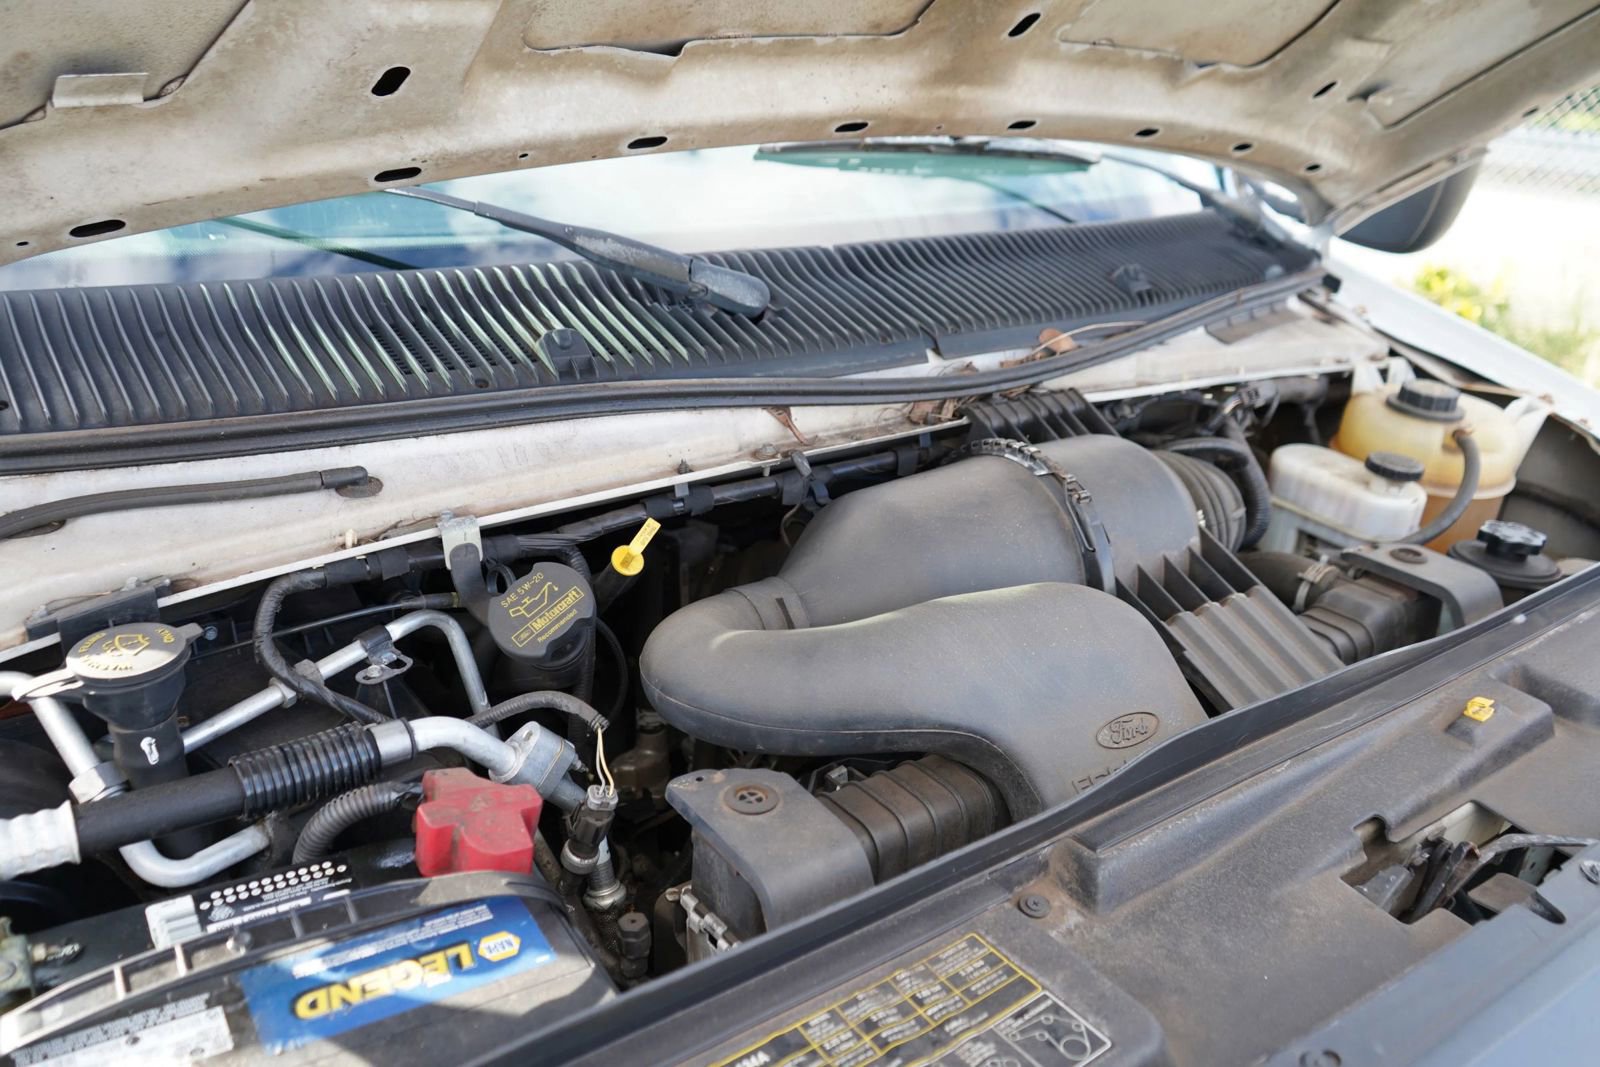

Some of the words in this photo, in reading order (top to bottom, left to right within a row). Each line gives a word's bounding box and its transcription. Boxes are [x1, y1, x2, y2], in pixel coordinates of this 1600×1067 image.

[501, 592, 518, 608] SAE
[517, 572, 544, 595] 5W-20
[532, 590, 579, 630] Motorcraft
[1109, 717, 1148, 745] Ford
[294, 940, 475, 1020] LEGEND
